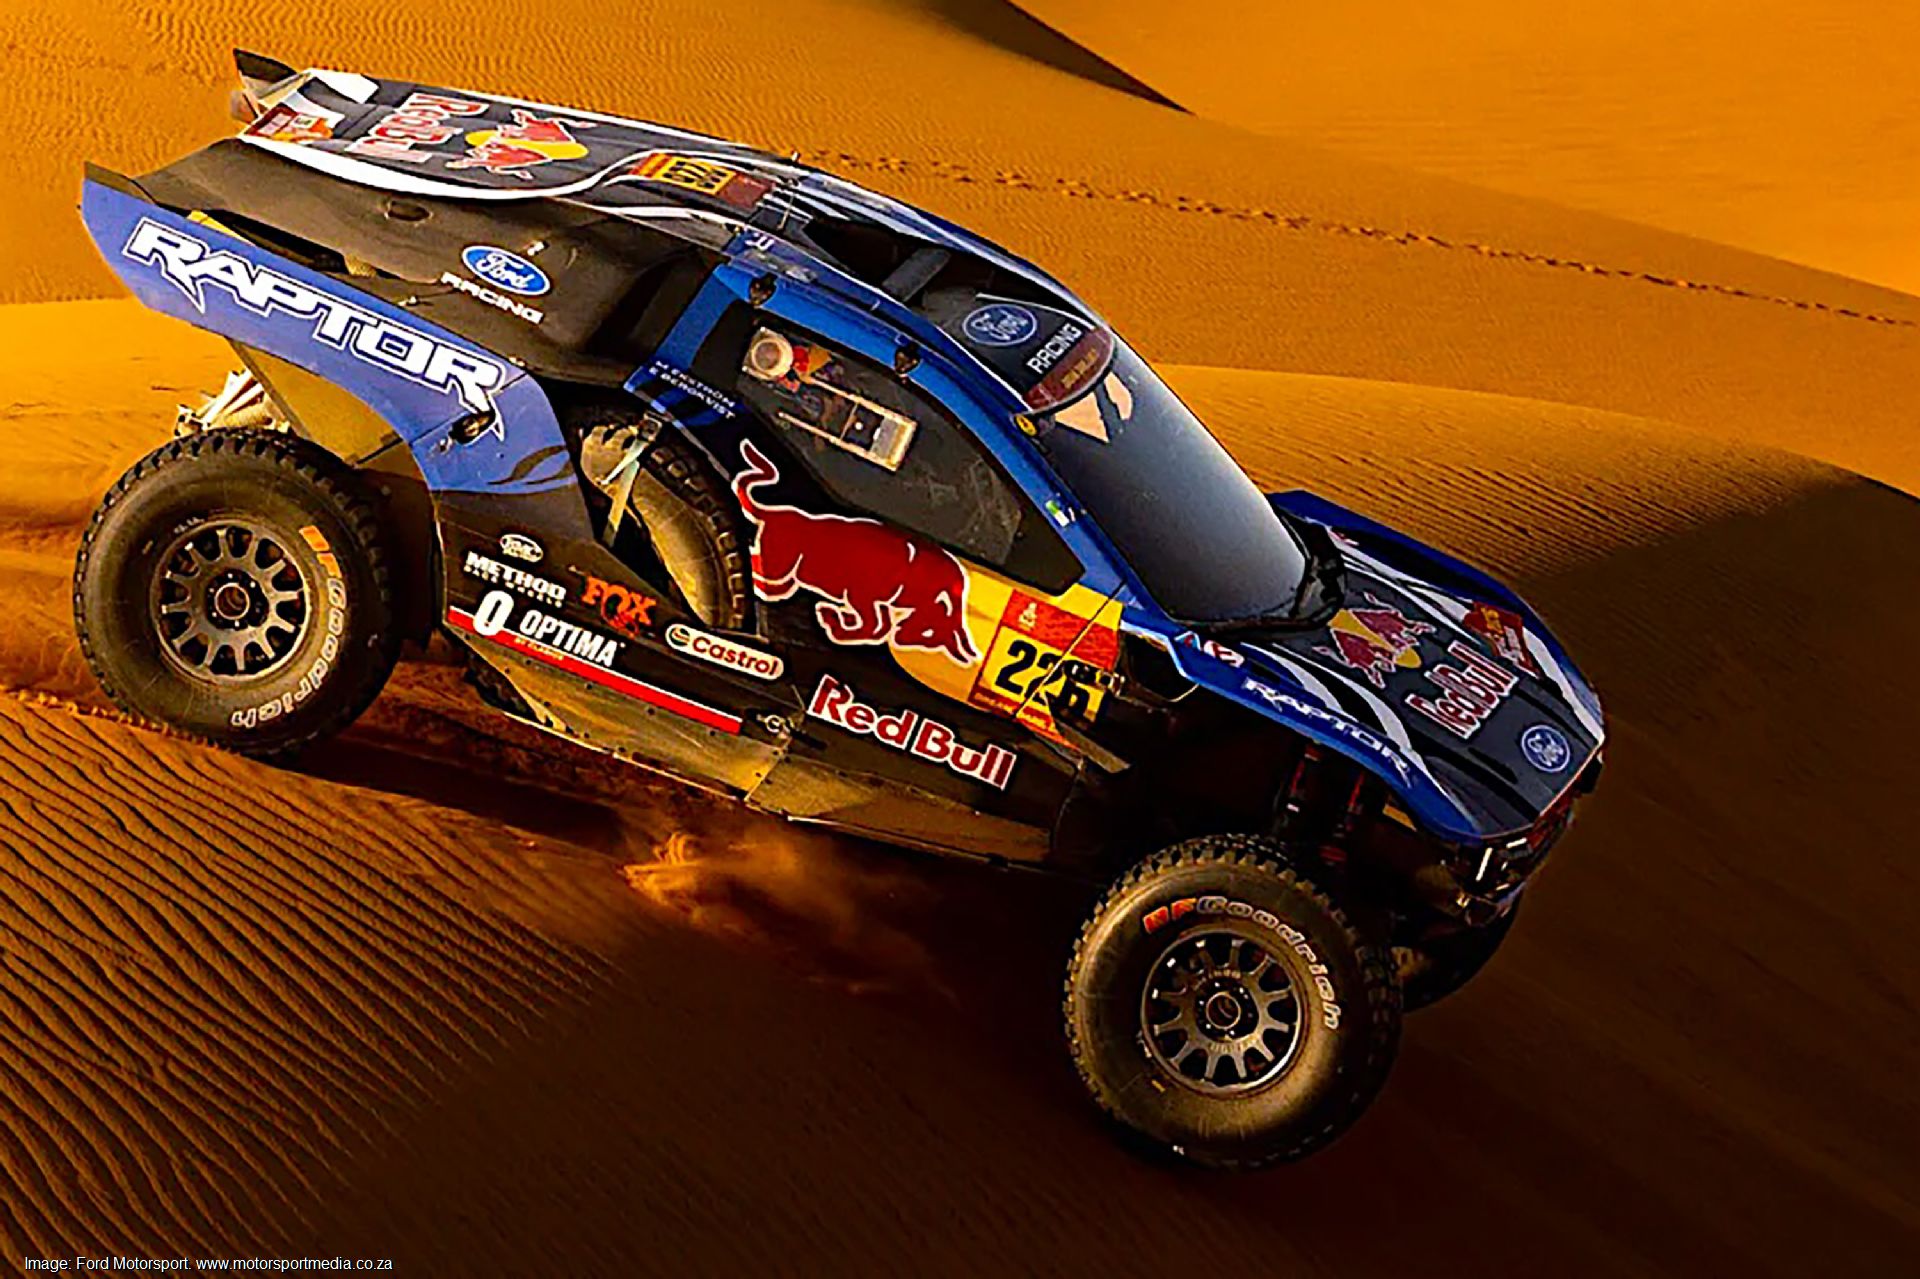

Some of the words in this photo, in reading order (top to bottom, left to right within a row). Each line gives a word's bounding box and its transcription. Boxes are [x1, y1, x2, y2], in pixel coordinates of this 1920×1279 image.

[440, 271, 544, 325] RACING
[473, 250, 538, 289] Ford
[121, 216, 507, 441] RAPTOR
[1026, 323, 1082, 374] RACING
[465, 551, 567, 600] METHOD
[582, 576, 656, 636] FOX
[520, 609, 618, 667] OPTIMA
[692, 636, 779, 676] Castrol
[1433, 640, 1519, 709] Bull
[807, 674, 918, 749] Red
[911, 718, 1017, 790] Bull
[1243, 677, 1412, 789] RAPTOR
[1405, 670, 1491, 739] Red
